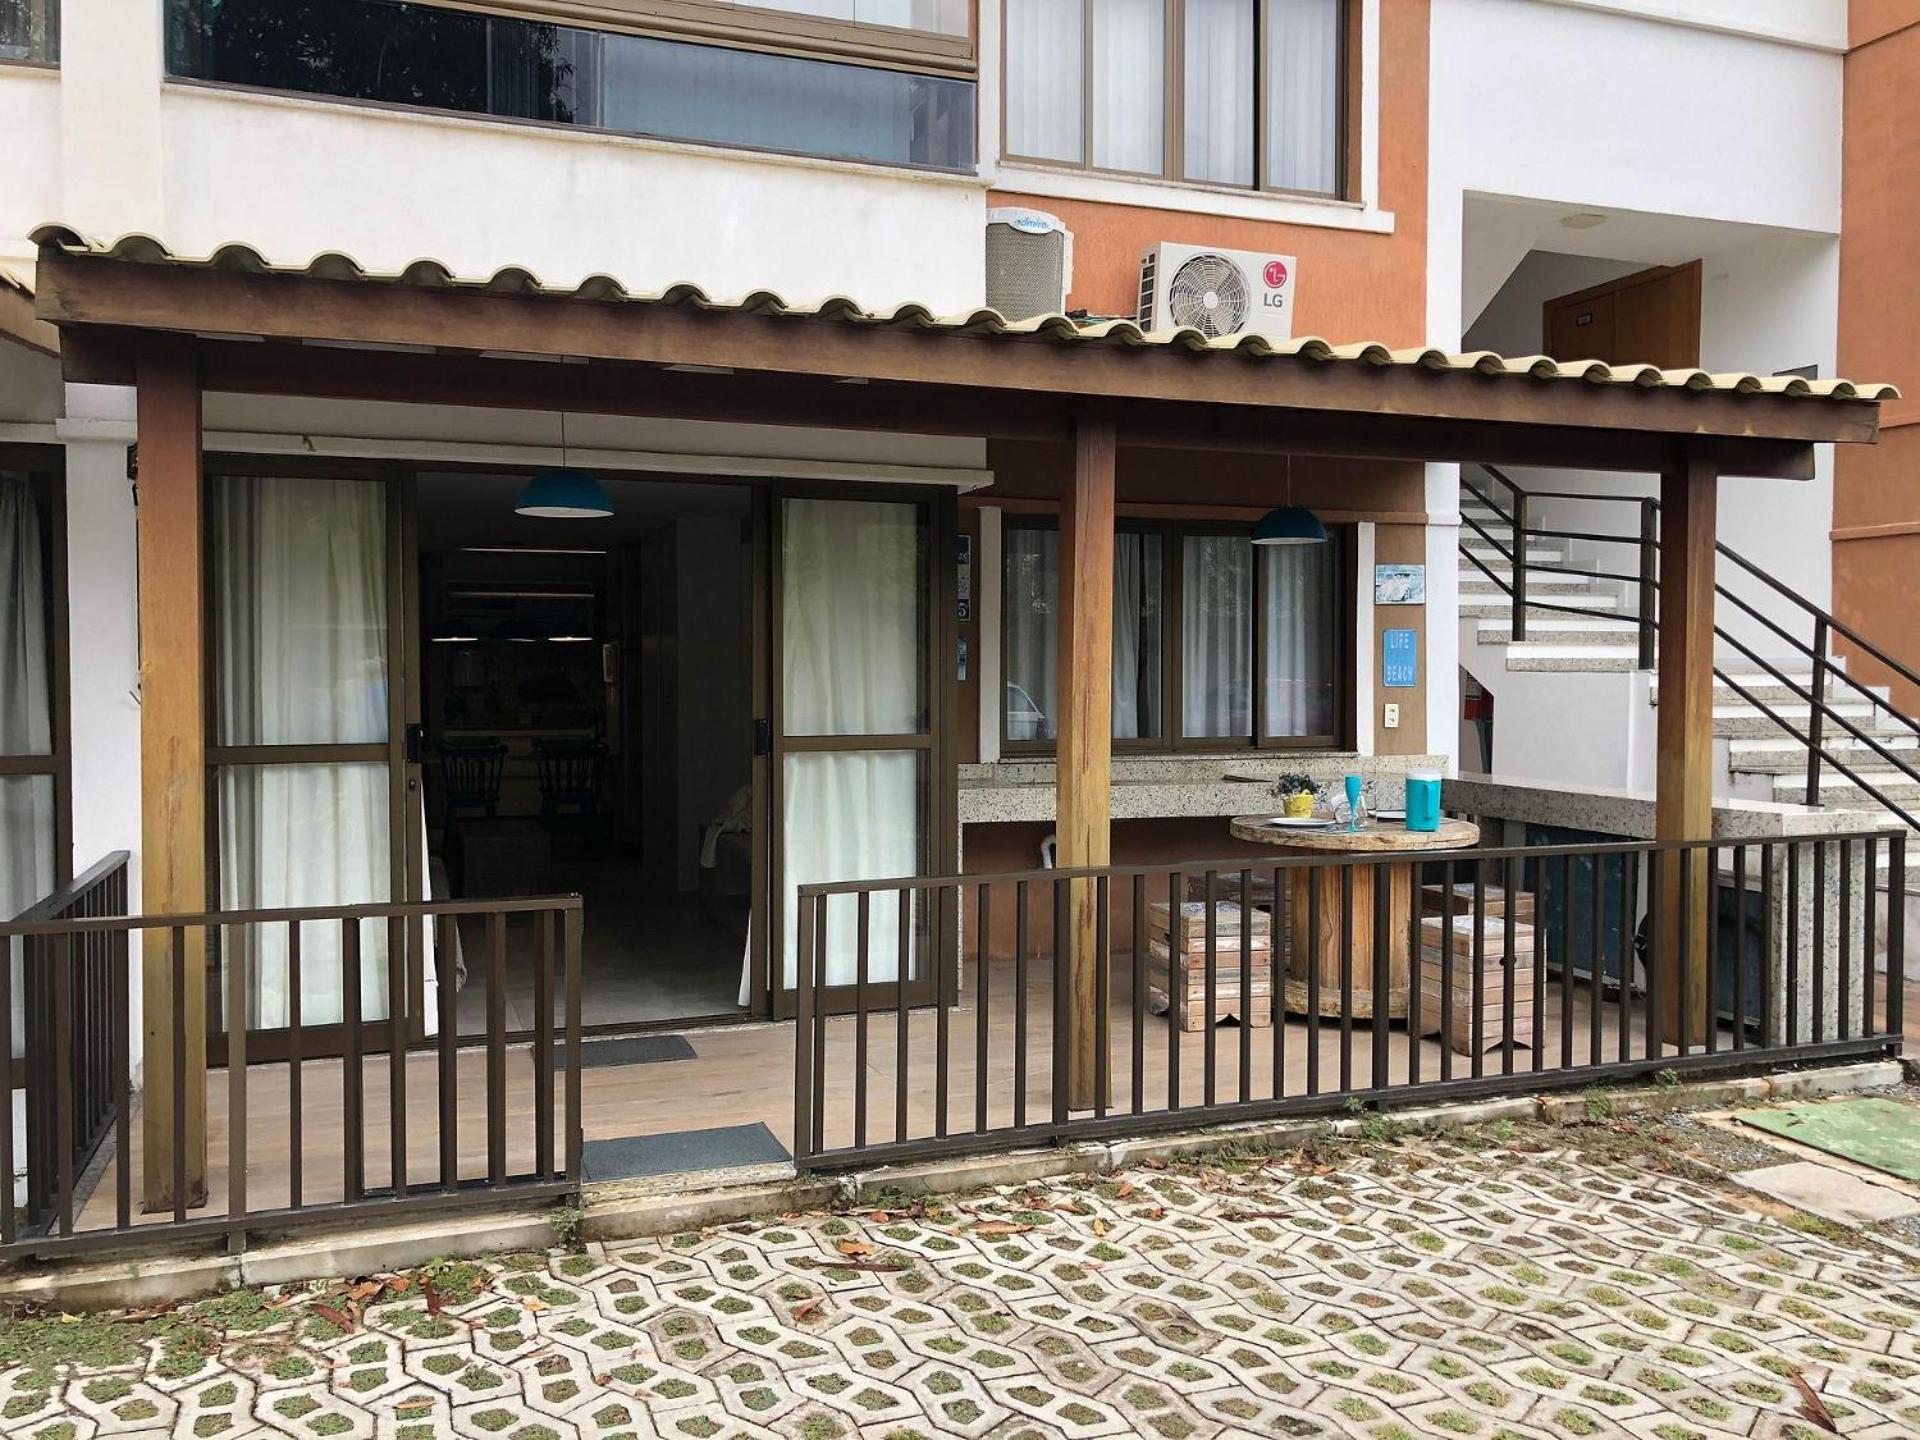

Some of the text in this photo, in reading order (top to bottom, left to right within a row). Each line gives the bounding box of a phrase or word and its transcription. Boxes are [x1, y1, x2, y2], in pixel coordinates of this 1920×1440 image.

[1263, 293, 1283, 308] LG
[1390, 633, 1410, 649] LIFE
[1386, 665, 1414, 682] BEACH
